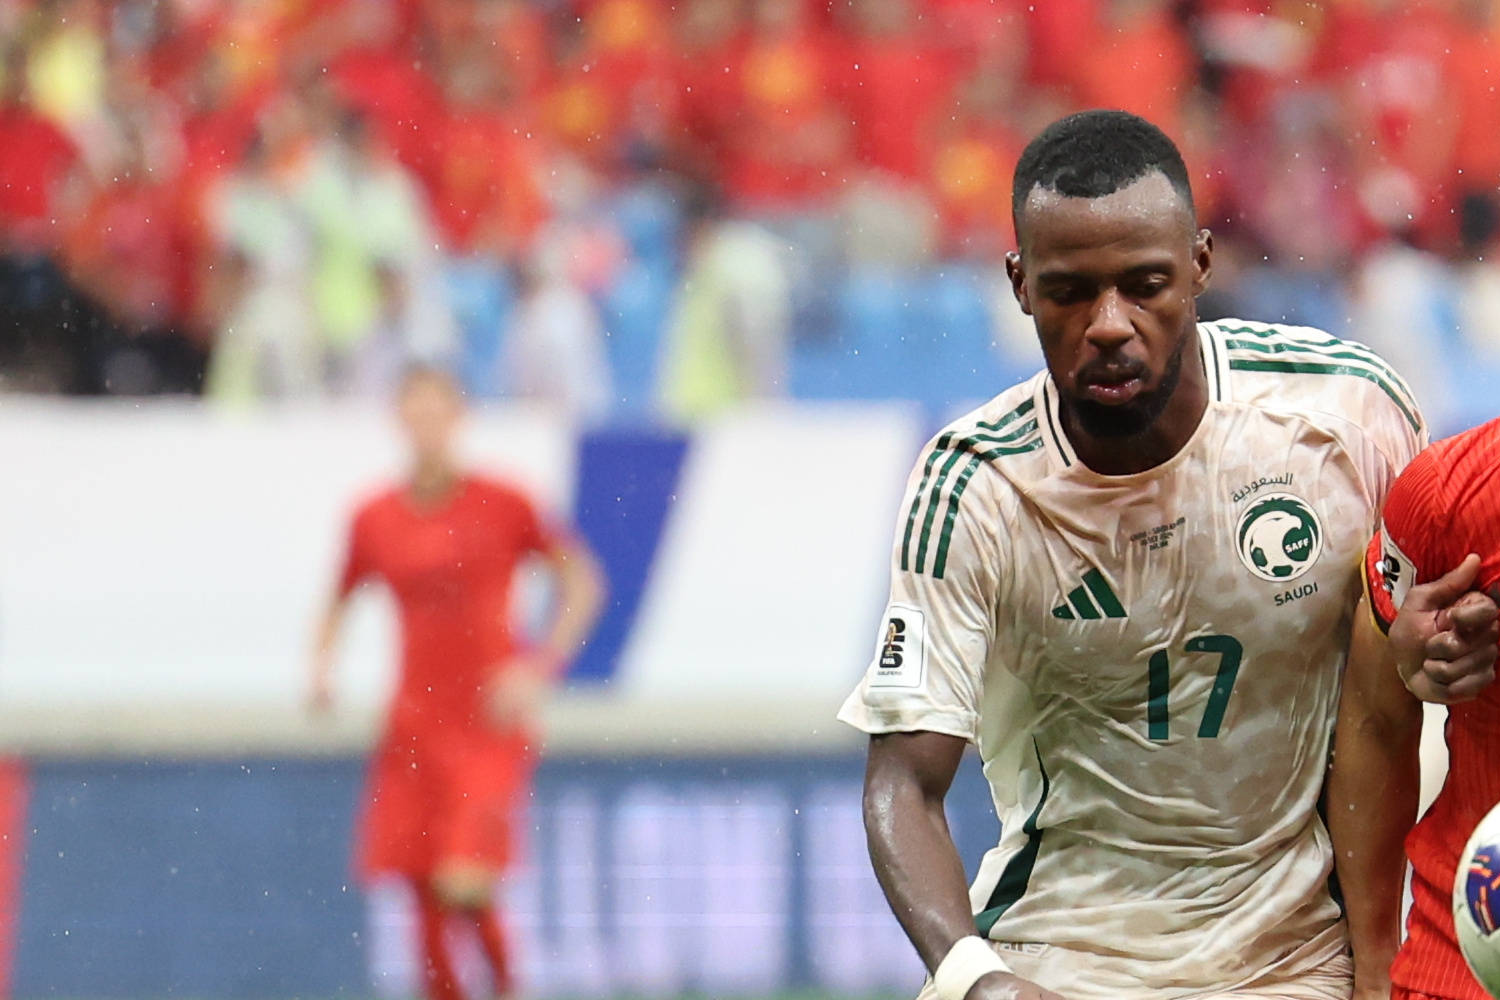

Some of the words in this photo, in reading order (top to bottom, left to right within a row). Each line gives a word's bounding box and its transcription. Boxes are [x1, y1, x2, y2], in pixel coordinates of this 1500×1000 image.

[1231, 472, 1293, 503] السعودية
[1285, 538, 1309, 553] SAFF
[1274, 582, 1318, 606] SAUDI
[1147, 635, 1243, 740] 17
